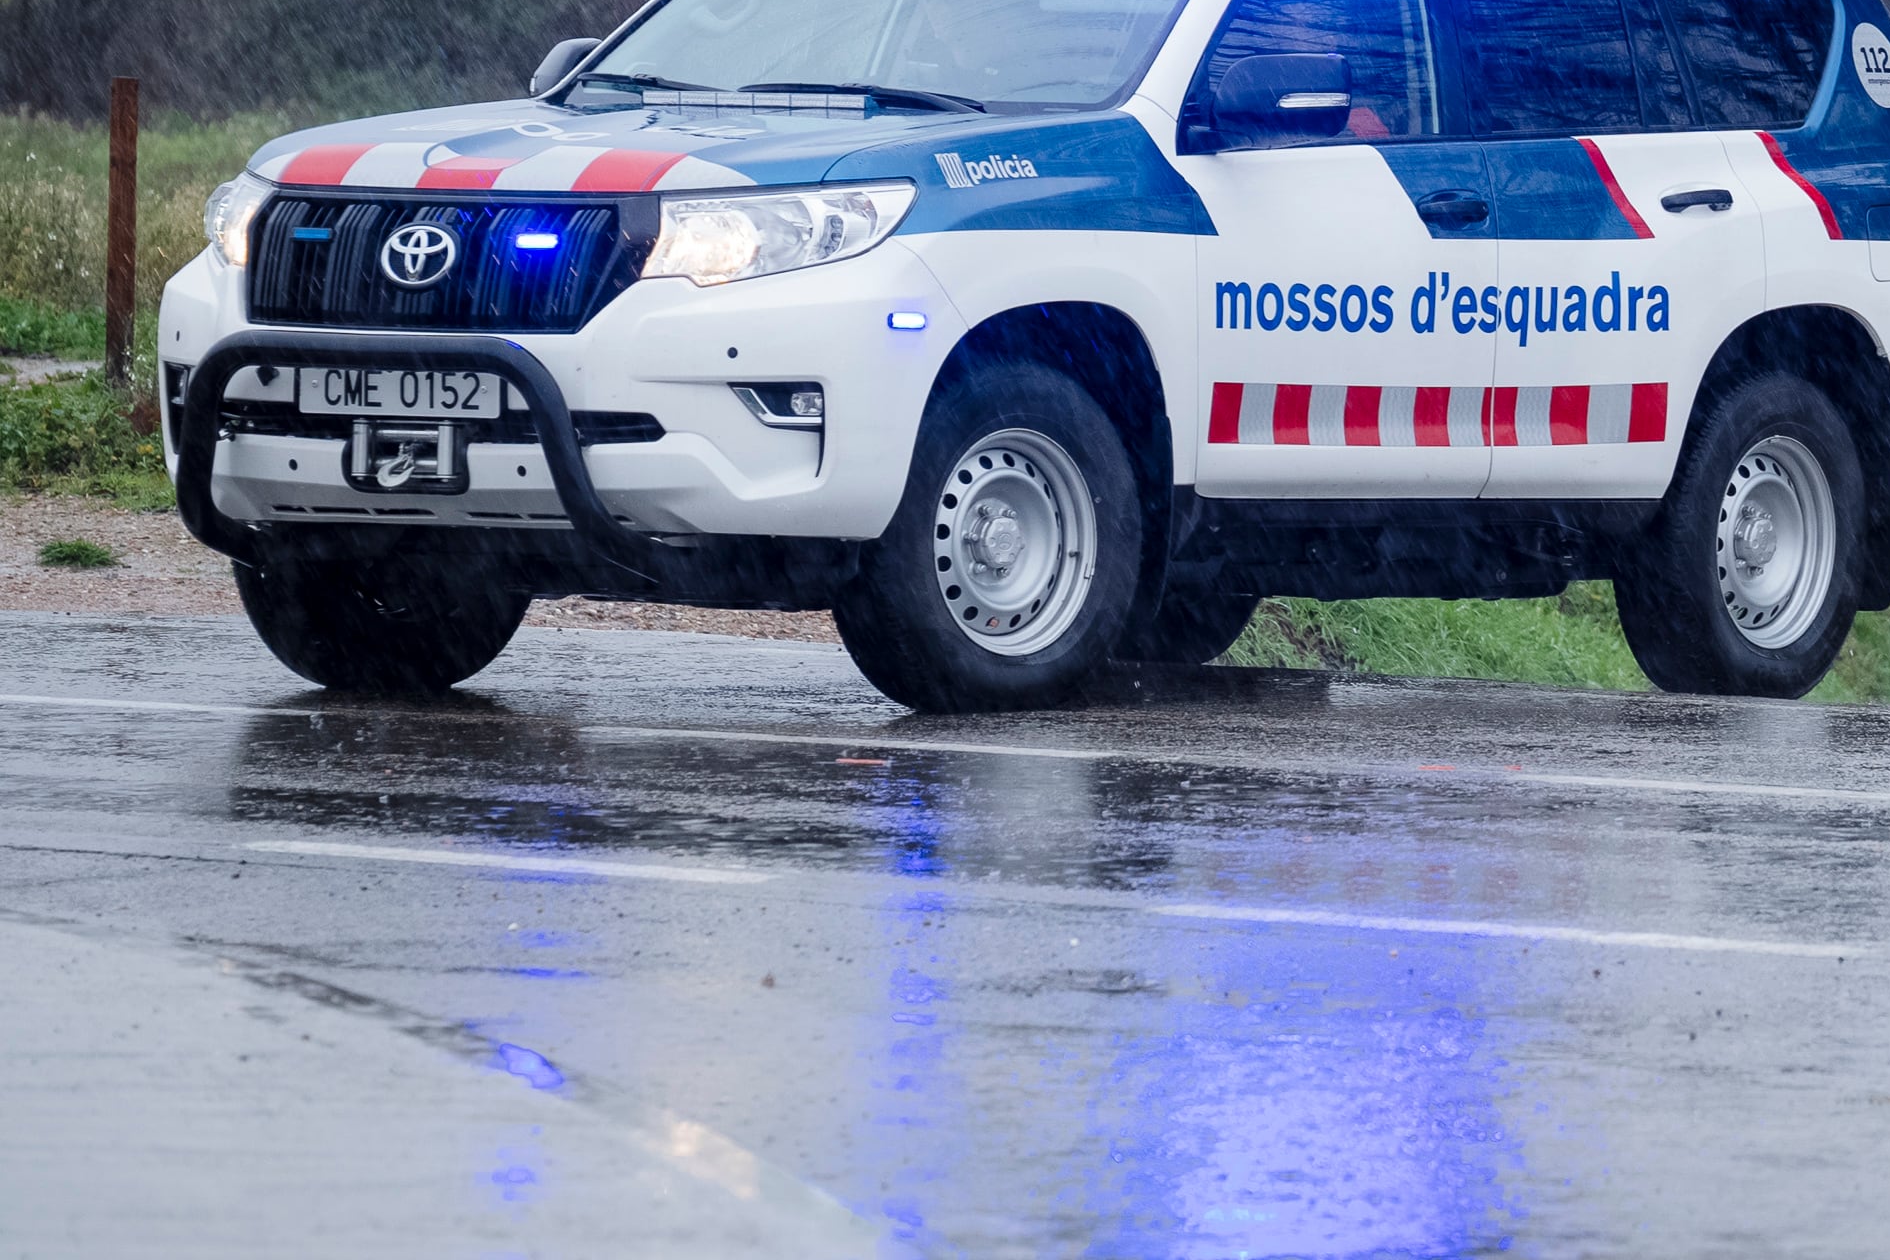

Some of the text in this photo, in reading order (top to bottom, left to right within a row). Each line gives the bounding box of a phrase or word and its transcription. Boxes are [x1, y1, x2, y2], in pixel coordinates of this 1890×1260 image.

[965, 154, 1039, 185] policia
[1215, 270, 1671, 348] mossos d'esquadra
[324, 369, 480, 411] CME 0152
